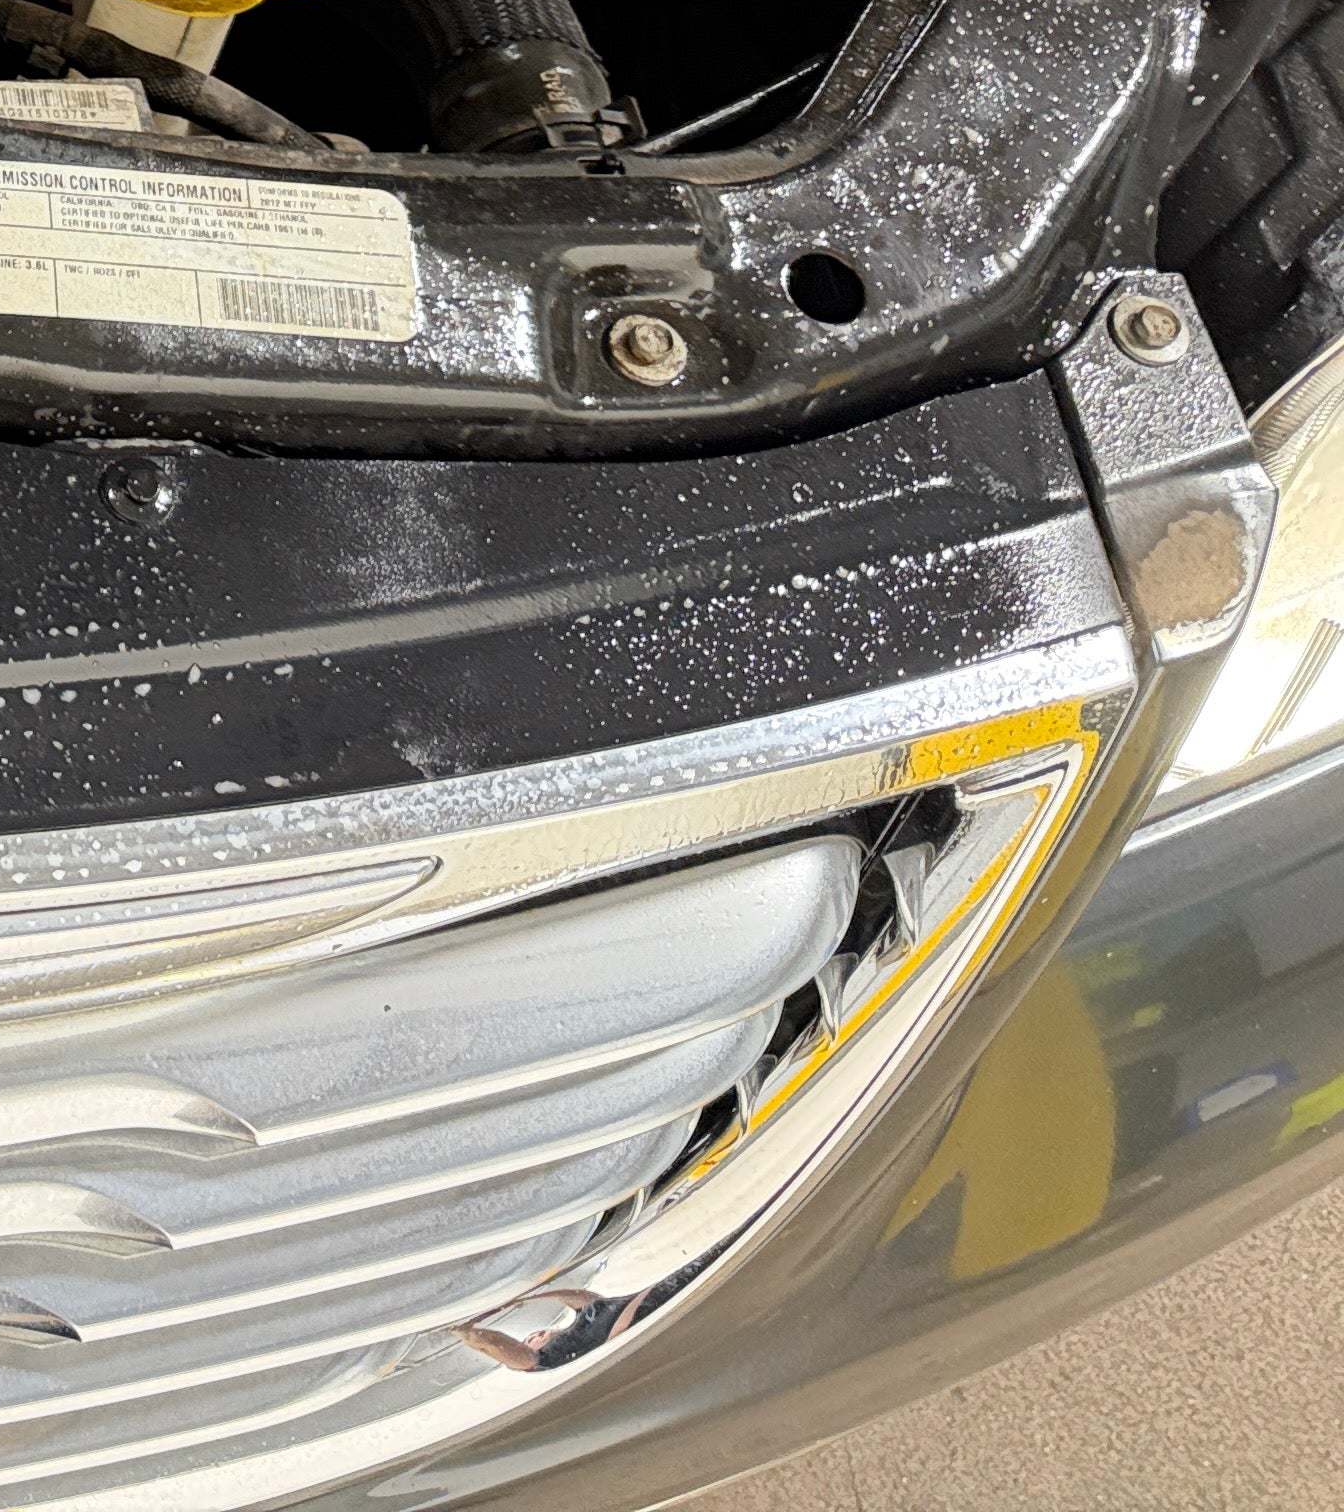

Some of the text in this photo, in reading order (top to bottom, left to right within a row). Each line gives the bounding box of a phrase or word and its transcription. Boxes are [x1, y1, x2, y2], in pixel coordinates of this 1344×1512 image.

[69, 175, 137, 194] CONTROL
[141, 180, 242, 203] INFORMATION
[61, 207, 106, 218] CERTIFIED
[109, 211, 120, 220] TO
[25, 259, 48, 271] 3.6L
